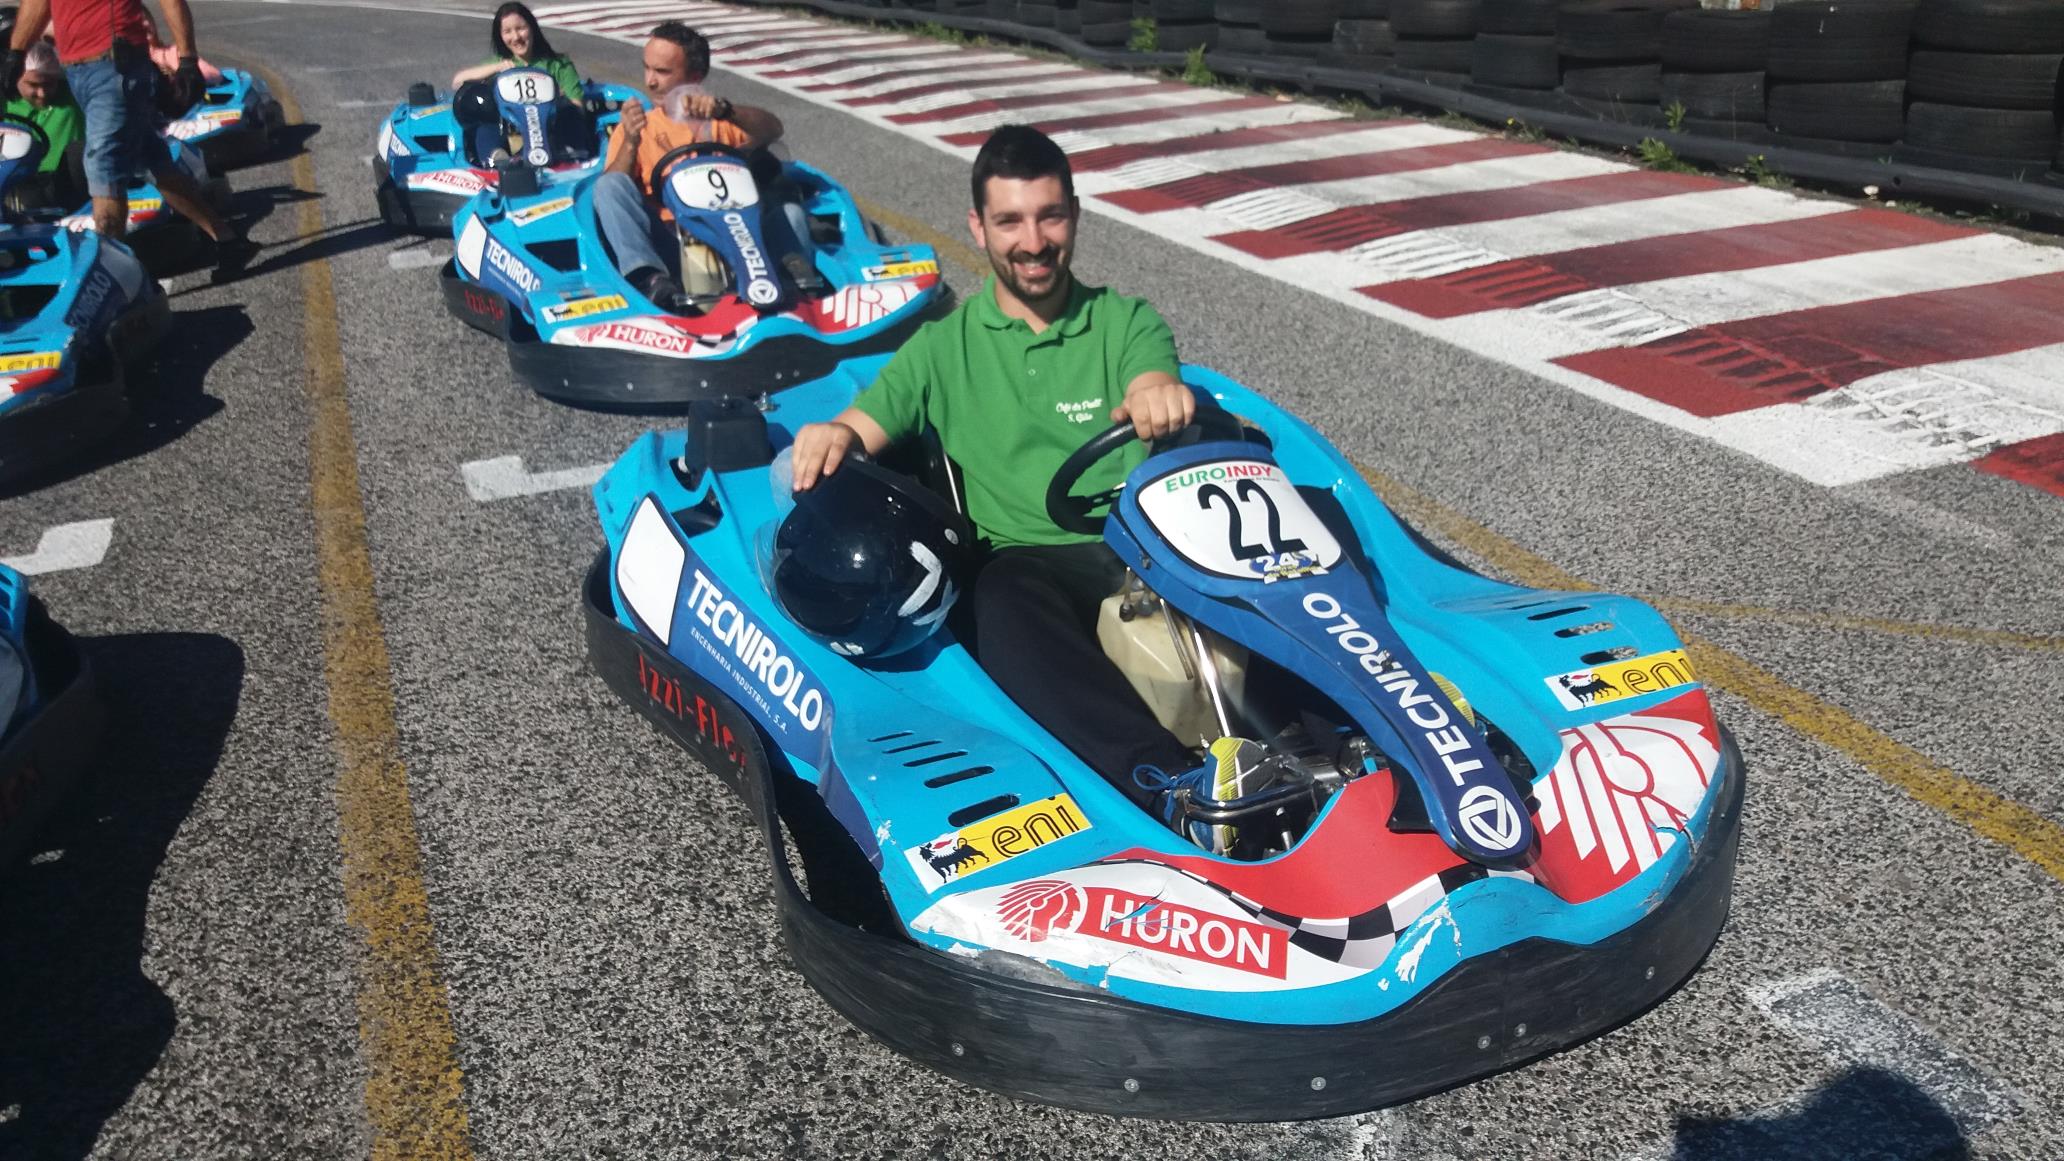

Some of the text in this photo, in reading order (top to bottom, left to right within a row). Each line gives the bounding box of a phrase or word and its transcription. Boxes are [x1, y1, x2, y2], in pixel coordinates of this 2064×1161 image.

[514, 79, 537, 99] 18
[707, 169, 728, 201] 9
[723, 212, 768, 280] TECNIROLO
[613, 324, 688, 352] HURON
[1165, 465, 1273, 493] EUROINDY
[1197, 479, 1309, 561] 22
[687, 568, 823, 732] TECNIROLO
[690, 627, 732, 673] ENGENHARIA
[1302, 592, 1485, 787] TECNIROLO
[1621, 657, 1698, 695] eni
[992, 804, 1080, 857] eni
[1100, 893, 1271, 969] HURON
